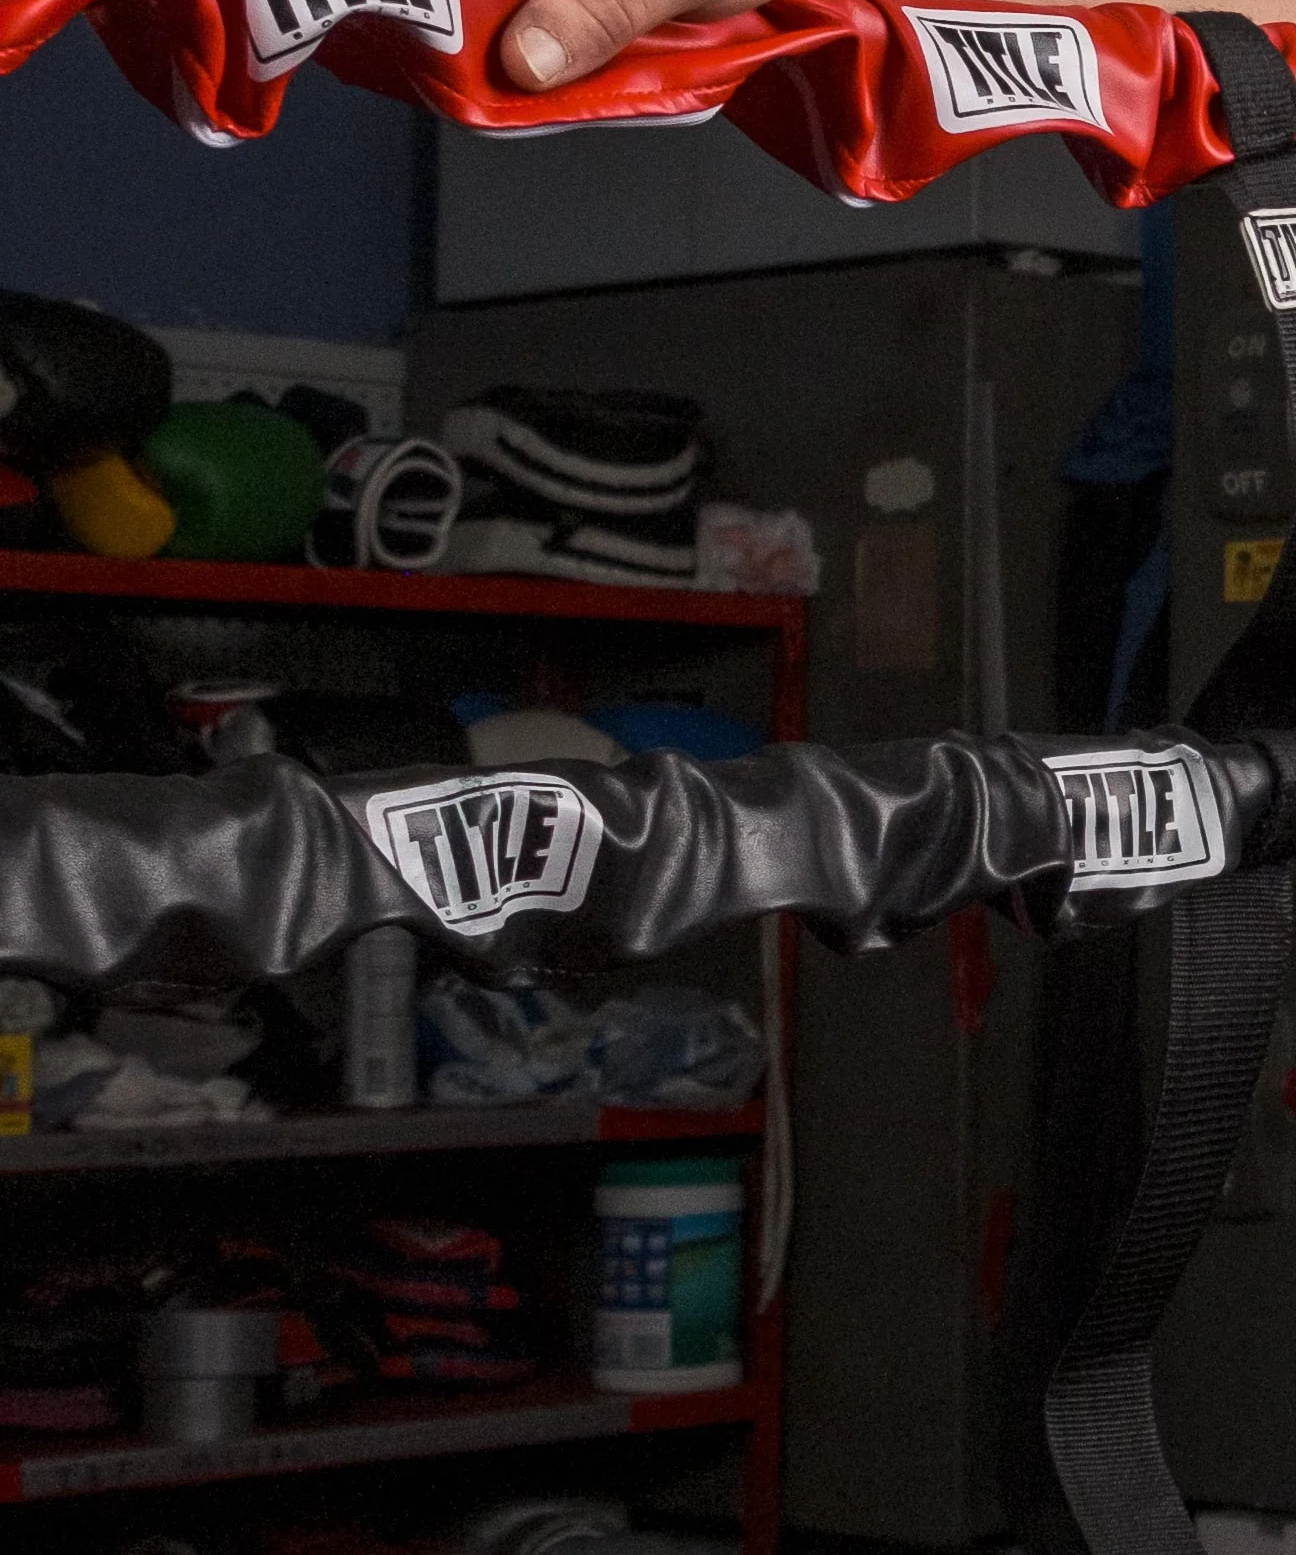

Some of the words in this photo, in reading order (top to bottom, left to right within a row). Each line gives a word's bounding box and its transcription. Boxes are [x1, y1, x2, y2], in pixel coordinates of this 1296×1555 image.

[932, 24, 1076, 110] TITLE
[404, 789, 559, 909] TITLE
[1061, 769, 1182, 861] TITLE
[445, 881, 531, 917] BOXNG
[1078, 855, 1175, 869] BOXING
